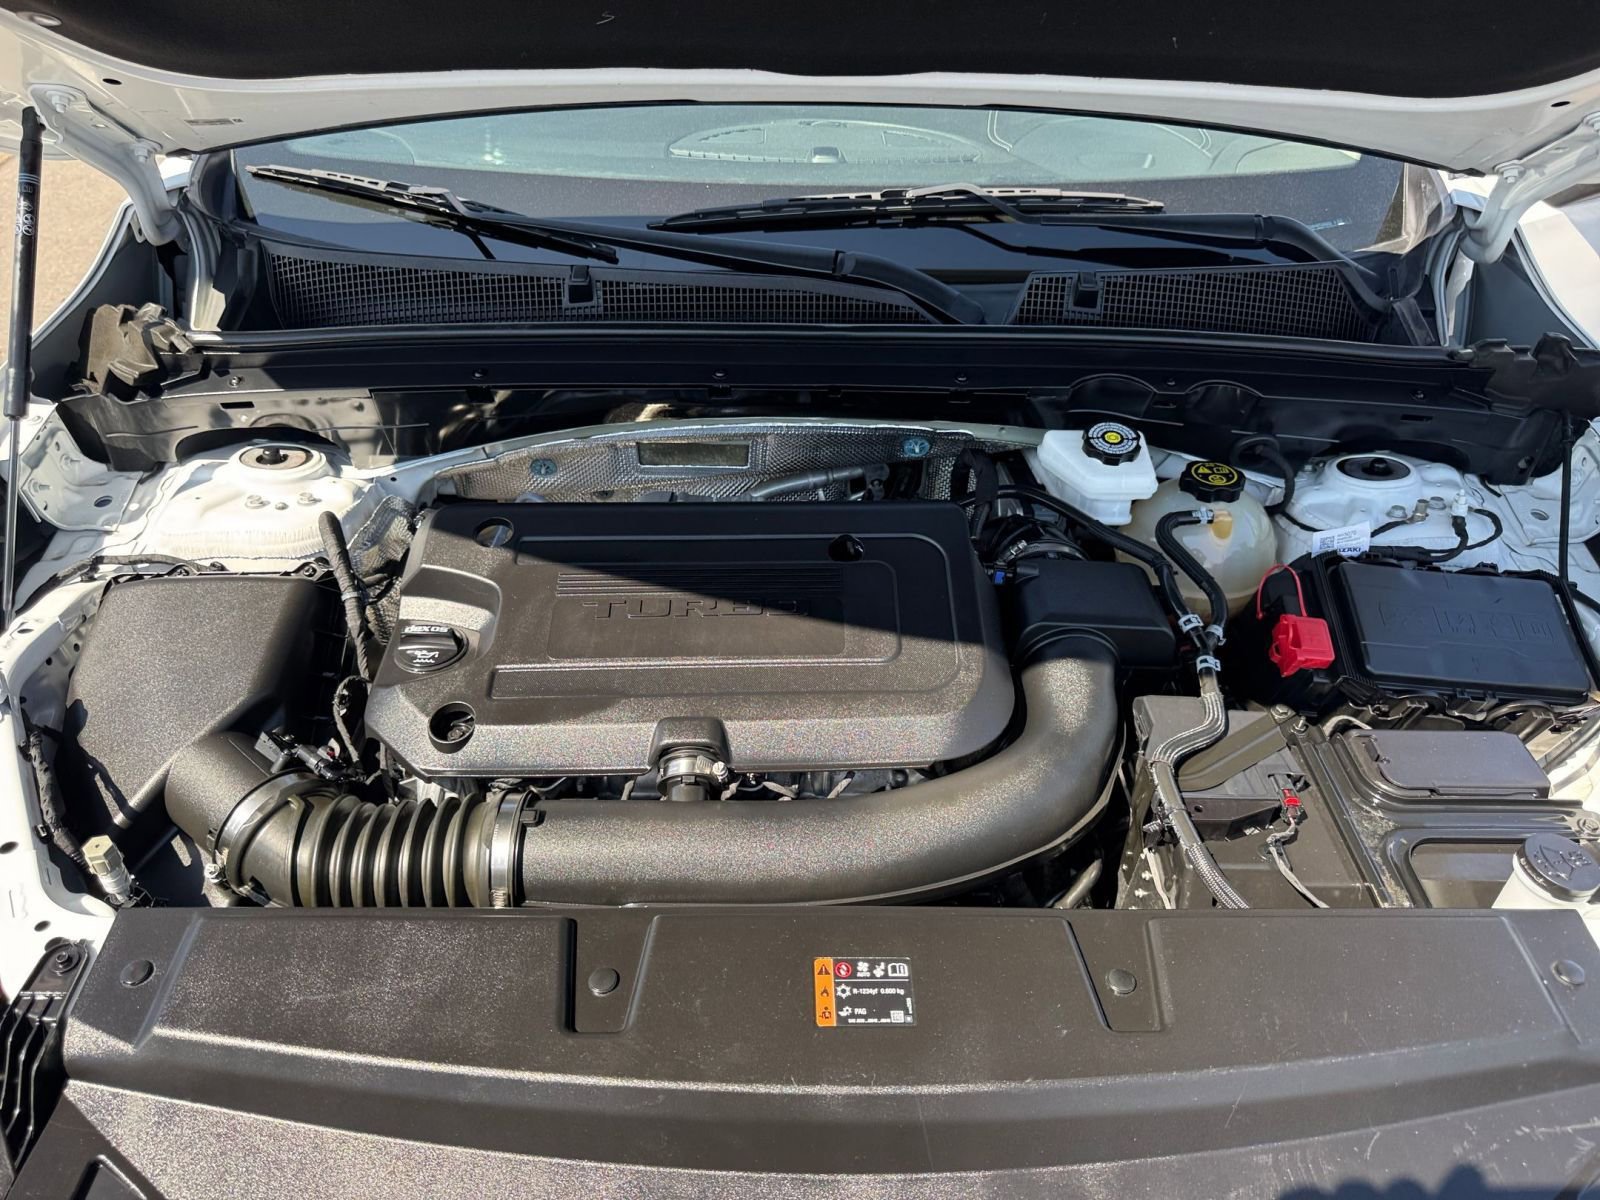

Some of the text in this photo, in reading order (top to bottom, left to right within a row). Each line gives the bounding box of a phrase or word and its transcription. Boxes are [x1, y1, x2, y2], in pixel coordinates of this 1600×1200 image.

[582, 597, 809, 619] TURBO
[404, 625, 449, 633] dexos
[897, 987, 905, 996] kg
[854, 1007, 867, 1015] PAG
